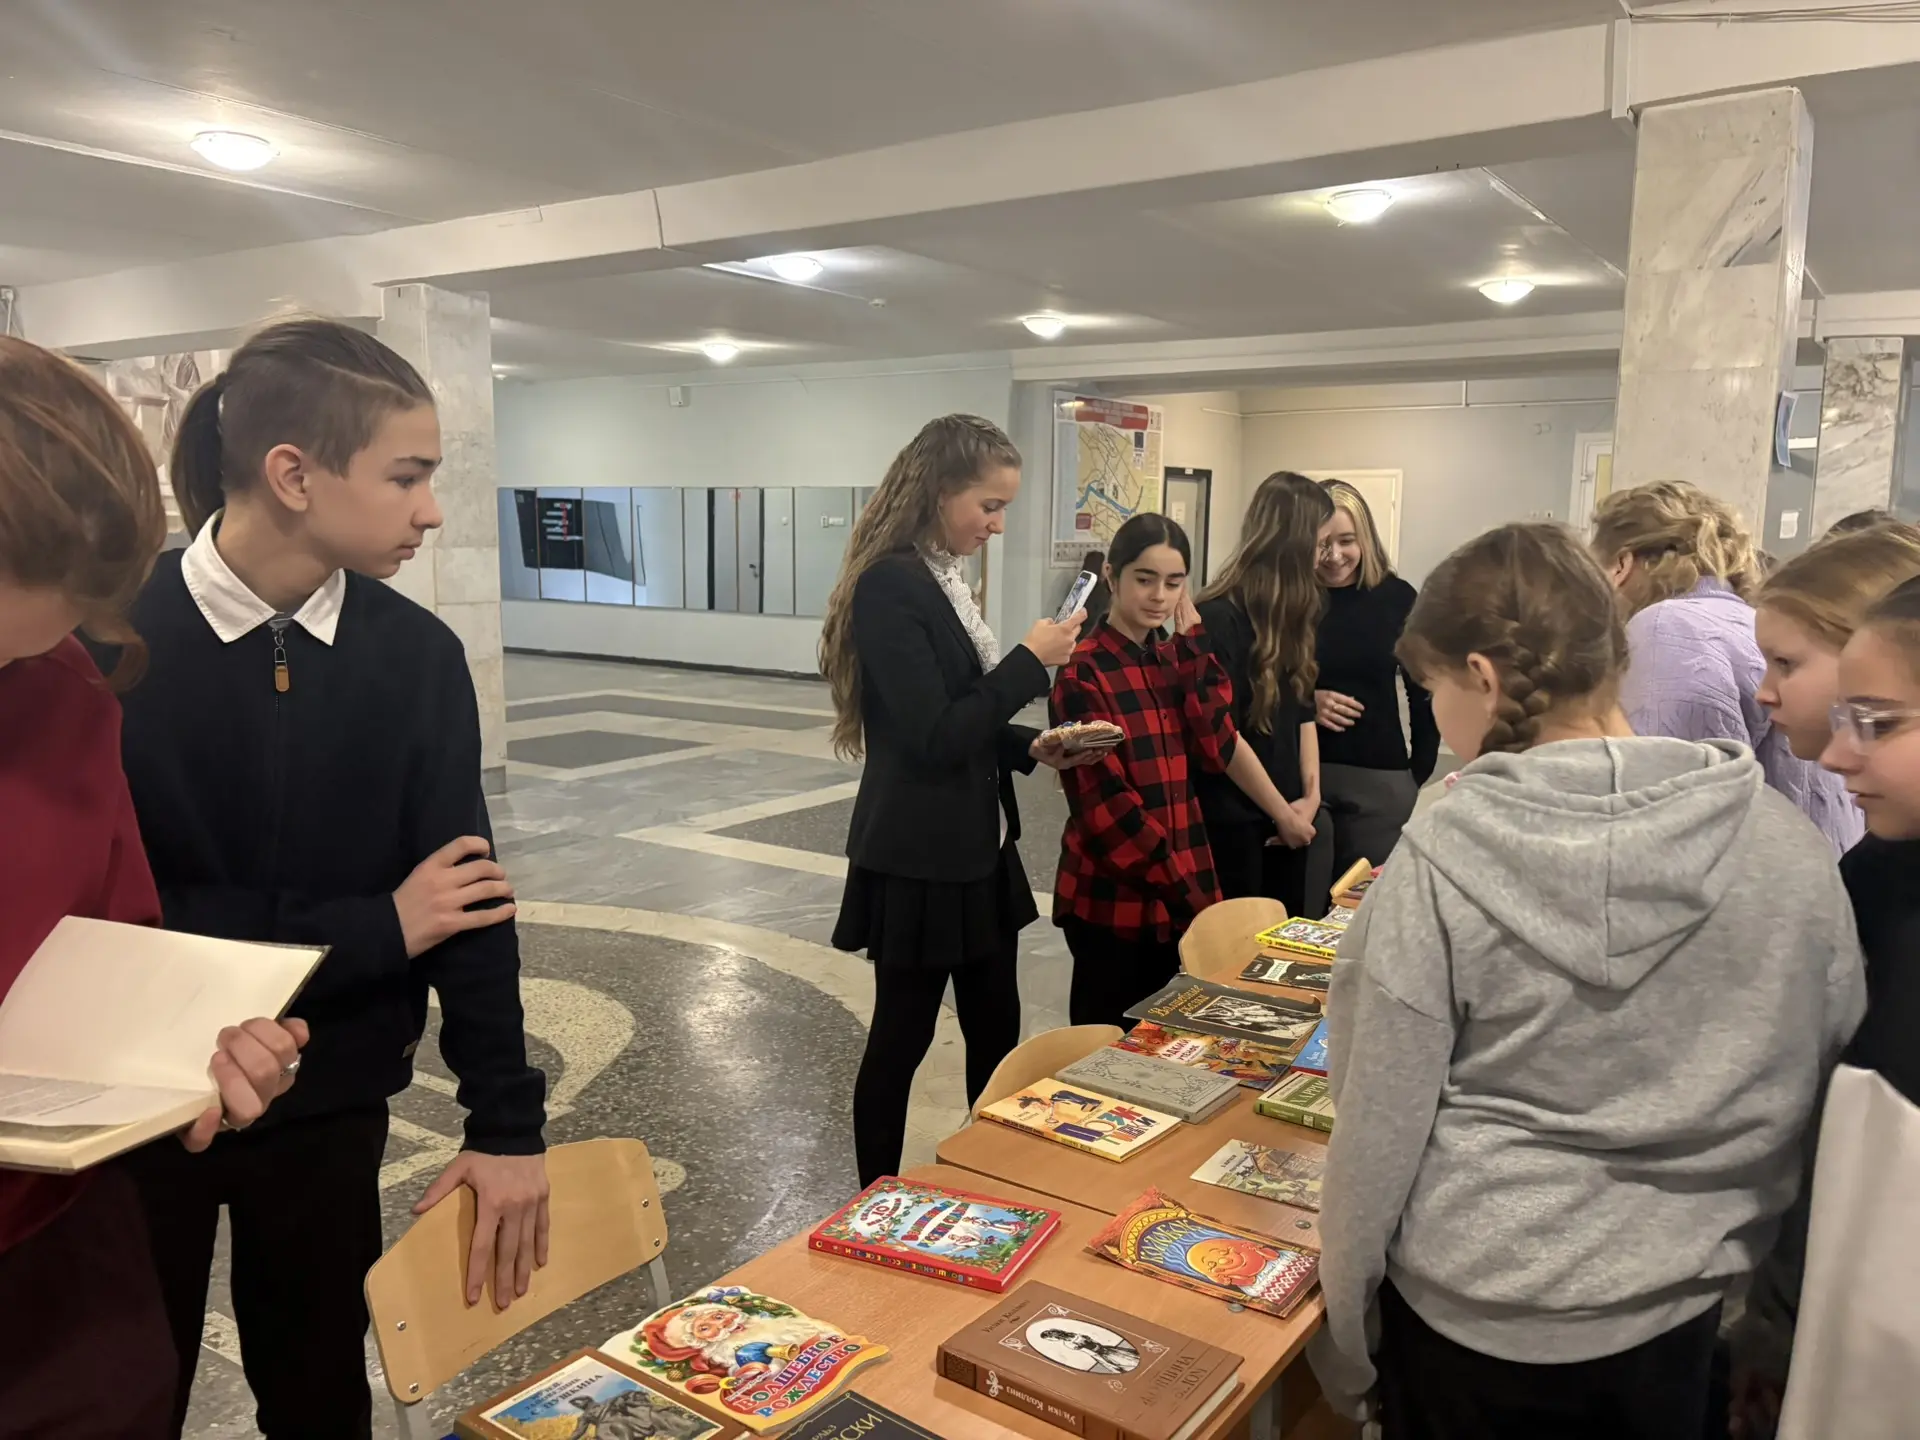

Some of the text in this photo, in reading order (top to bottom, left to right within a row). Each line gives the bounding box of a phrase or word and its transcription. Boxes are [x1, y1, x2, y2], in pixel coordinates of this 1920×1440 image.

[871, 1205, 890, 1216] 10
[1138, 1219, 1202, 1265] КОЛОБОК
[543, 1374, 603, 1409] ПУШКИНА
[732, 1333, 848, 1412] ВОЛШЕБНОЕ
[757, 1342, 862, 1418] РОЖДЕСТВО
[1006, 1385, 1076, 1425] Уилки Коллинз
